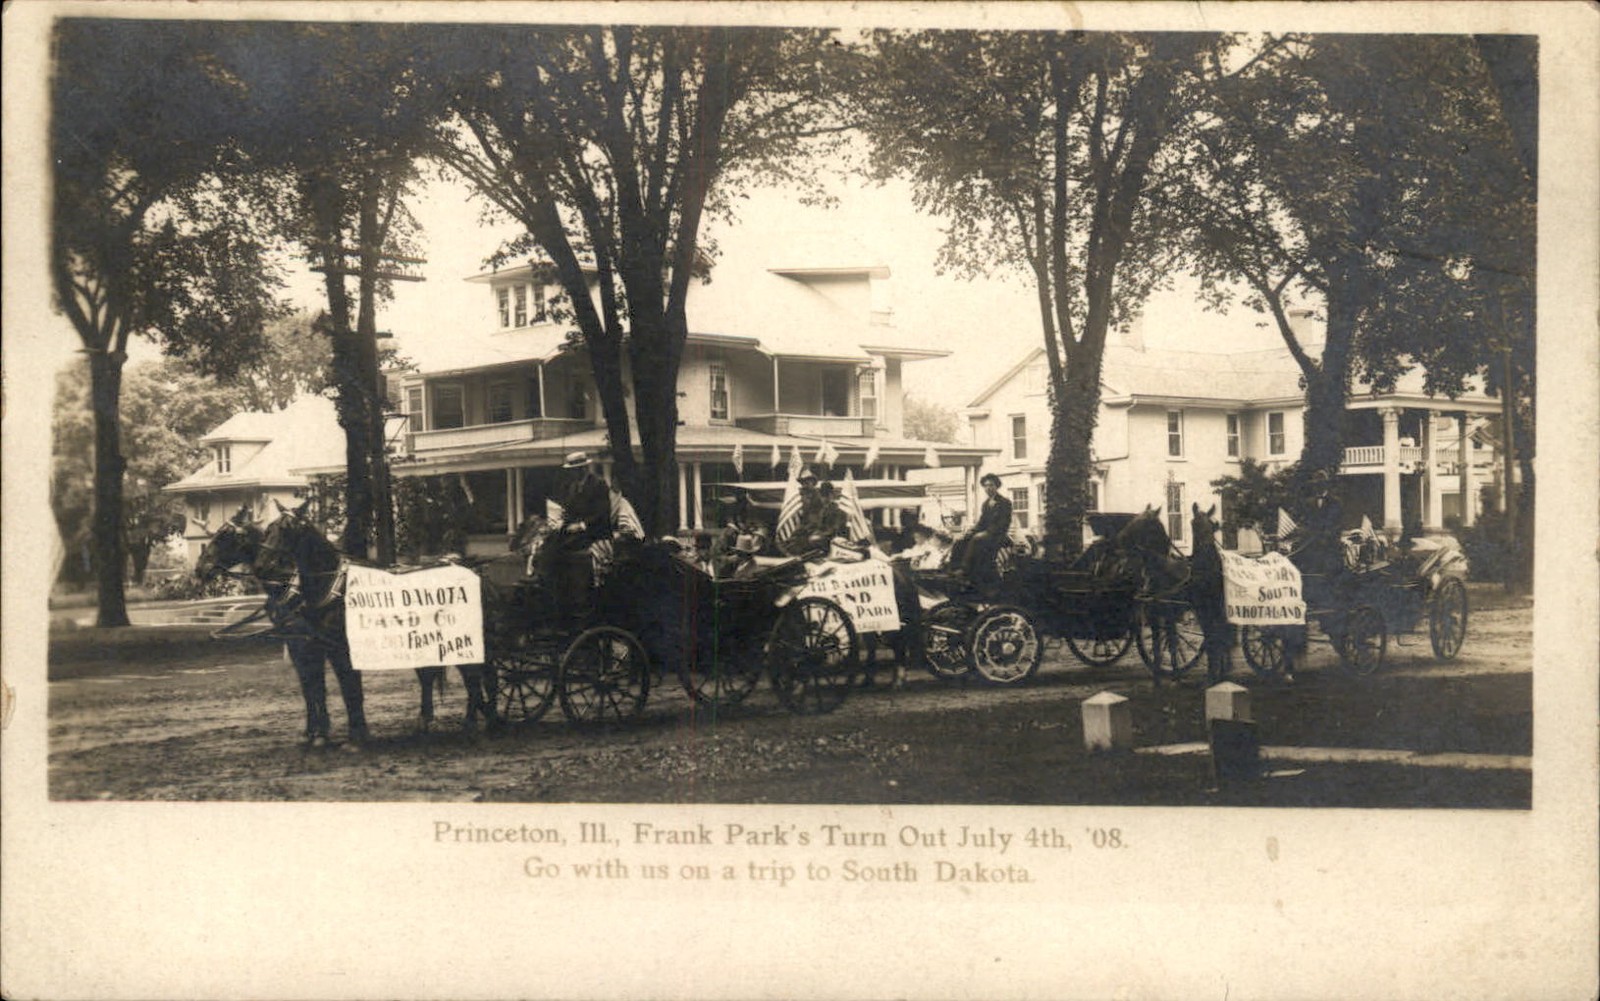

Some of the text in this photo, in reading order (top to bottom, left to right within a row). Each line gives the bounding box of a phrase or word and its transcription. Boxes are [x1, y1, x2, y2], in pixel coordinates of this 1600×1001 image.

[348, 586, 468, 608] SOUTH DAKOTA
[1258, 586, 1298, 602] SOUTH
